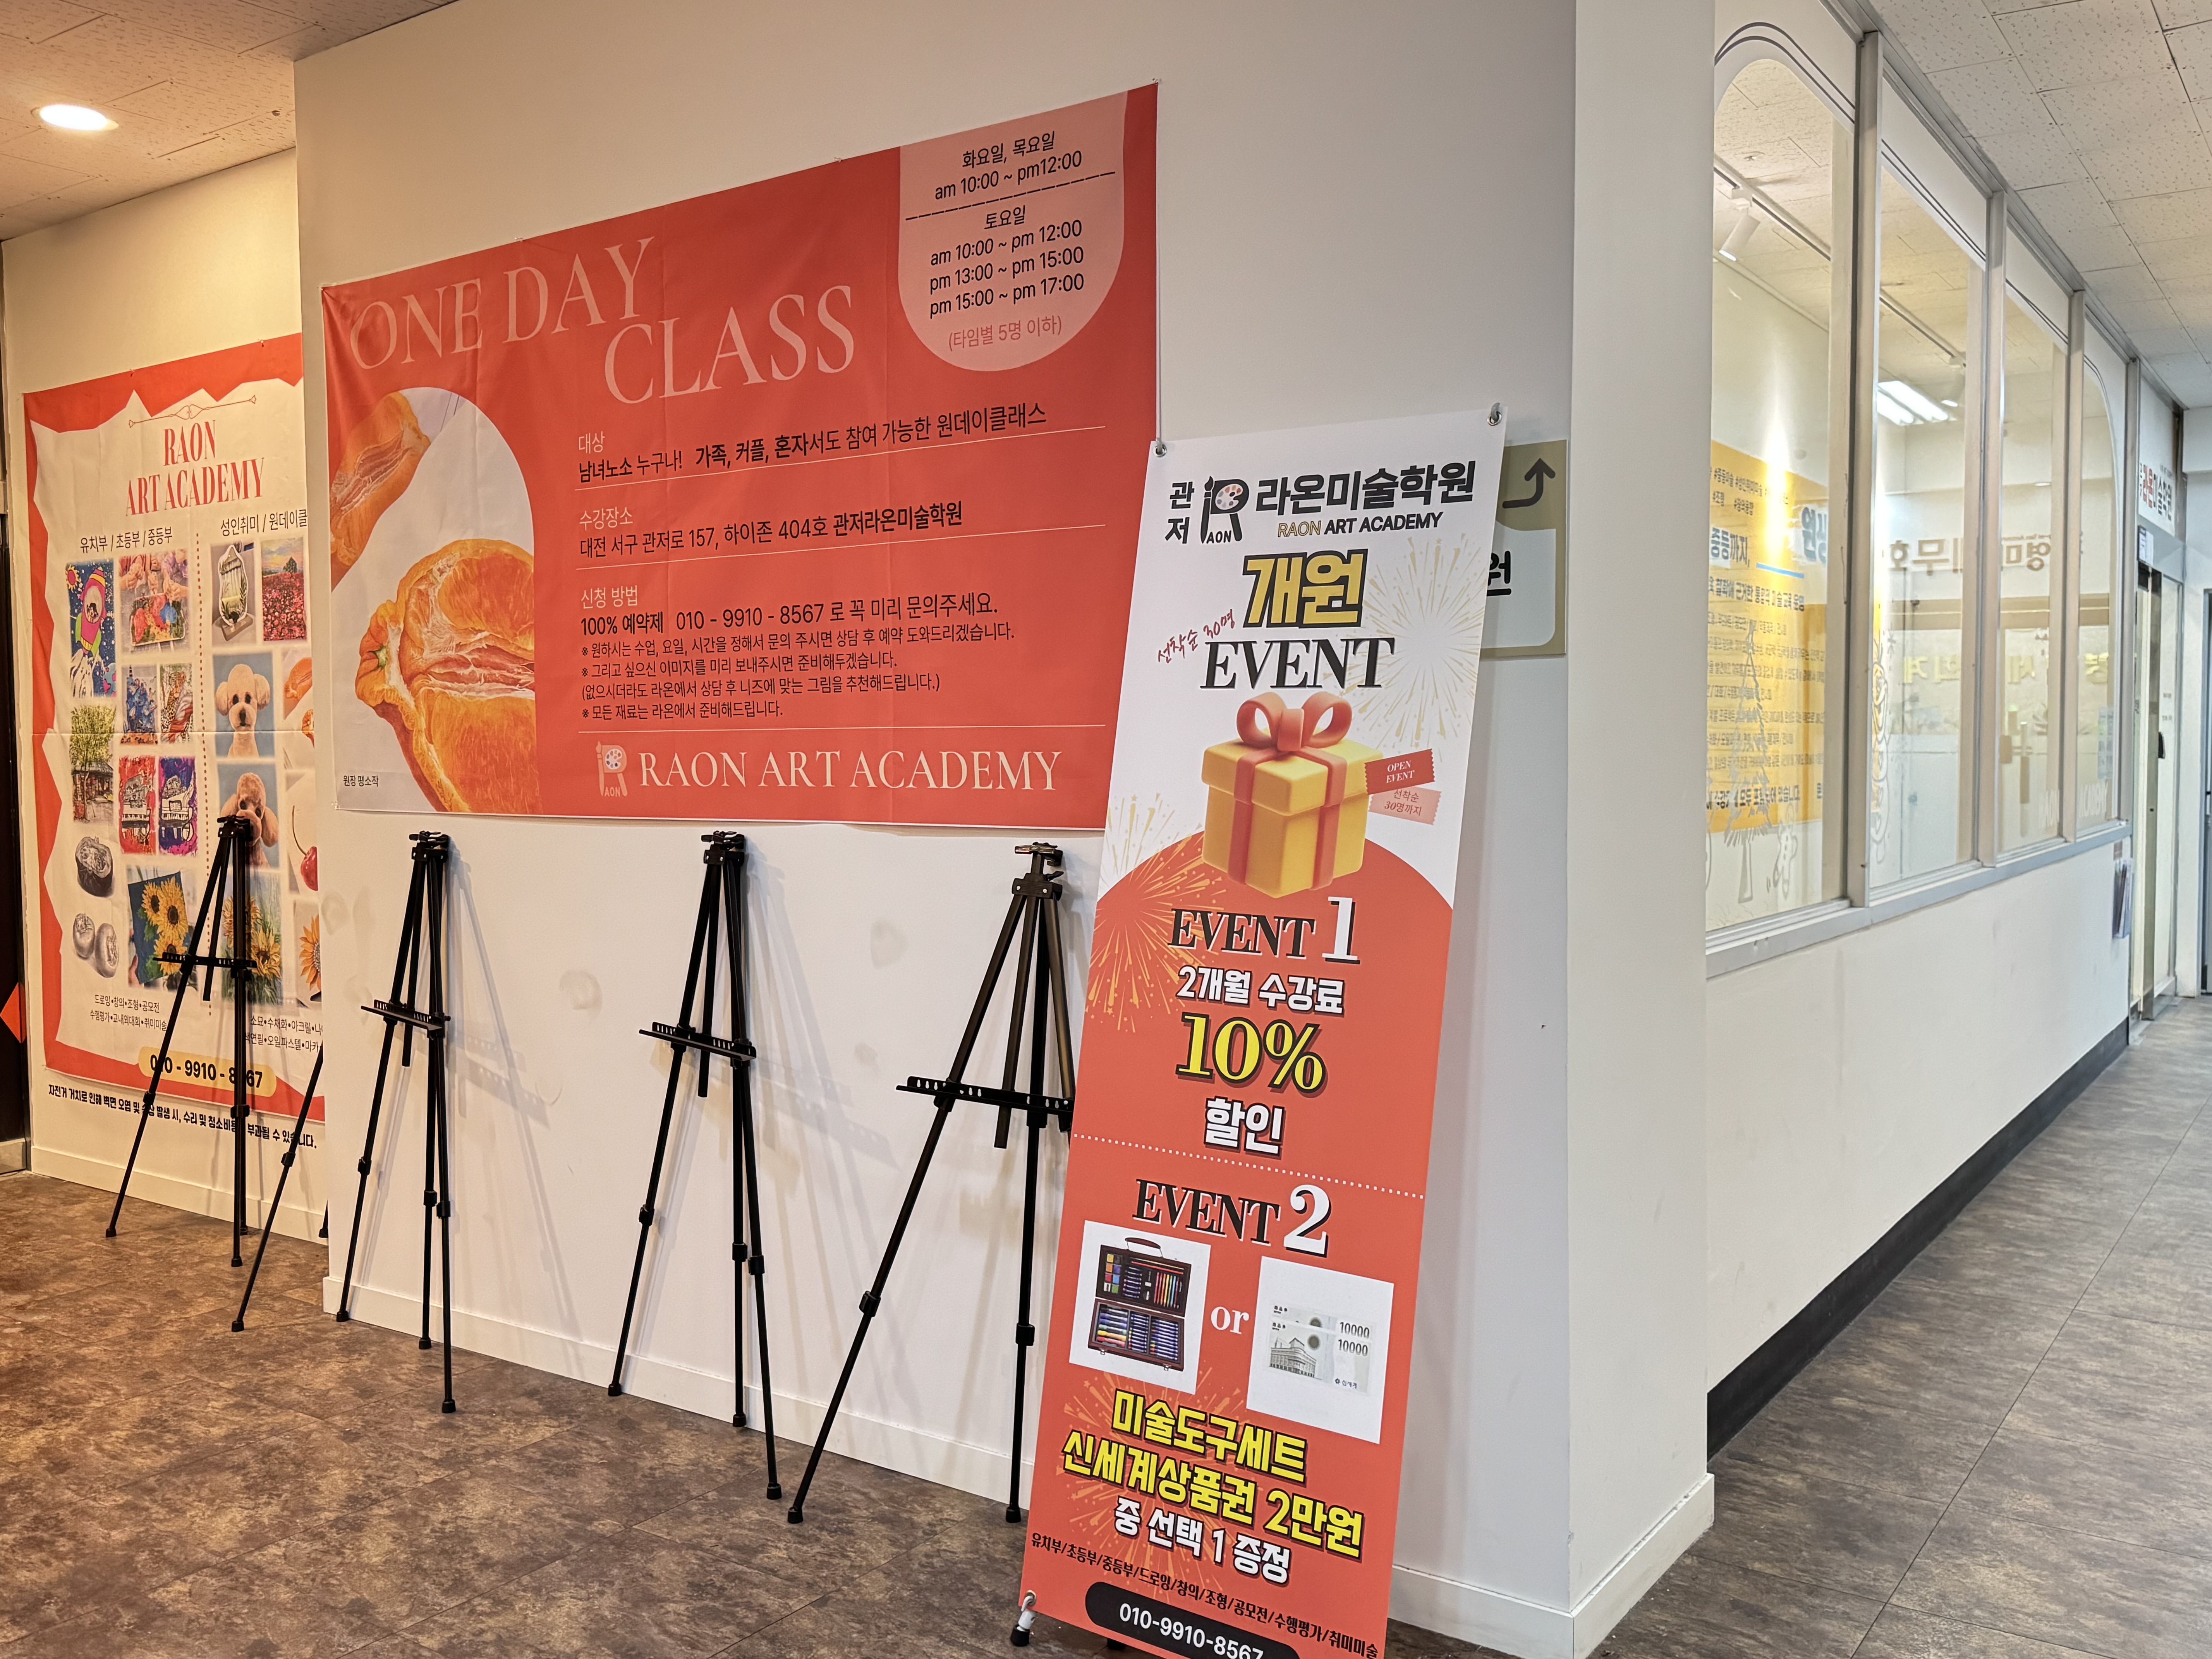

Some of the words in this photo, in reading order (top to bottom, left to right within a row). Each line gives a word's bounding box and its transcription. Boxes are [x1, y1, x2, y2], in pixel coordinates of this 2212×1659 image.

[962, 143, 1008, 169] 화요일,
[1012, 131, 1055, 157] 목요일
[934, 183, 957, 201] am
[960, 171, 1000, 195] 10:00
[1018, 150, 1082, 186] pm12:00
[984, 205, 1026, 230] 토요일
[931, 249, 951, 266] am
[955, 238, 994, 261] 10:00
[1011, 232, 1035, 252] pm
[1039, 219, 1083, 244] 12:00
[930, 275, 951, 295] pm
[955, 263, 994, 285] 13:00
[1012, 258, 1036, 279] pm
[1039, 246, 1085, 269] 15:00
[350, 278, 483, 370] ONE
[503, 236, 655, 343] DAY
[930, 300, 951, 319] pm
[955, 288, 994, 311] 15:00
[1013, 284, 1036, 305] pm
[1040, 273, 1085, 296] 17:00
[605, 285, 854, 404] CLASS
[949, 325, 994, 352] (타임별
[998, 320, 1022, 341] 5명
[1027, 315, 1062, 337] 이하)
[163, 419, 216, 467] RAON
[578, 431, 605, 454] 대상
[579, 457, 633, 483] 남녀노소
[636, 449, 682, 476] 누구나!
[696, 443, 732, 469] 가족,
[735, 438, 769, 464] 커플,
[774, 429, 841, 459] 혼자서도
[846, 423, 877, 450] 참여
[882, 416, 932, 444] 가능한
[936, 402, 1047, 438] 원데이클래스
[126, 473, 161, 517] ART
[164, 457, 264, 510] ACADEMY
[1255, 460, 1476, 516] 라온미술학원
[220, 517, 259, 536] 성인취미
[579, 507, 633, 531] 수강장소
[580, 535, 606, 558] 대전
[611, 534, 638, 555] 서구
[642, 530, 685, 553] 관저로
[689, 527, 719, 550] 157,
[724, 521, 773, 545] 하이존
[778, 515, 828, 539] 404호
[833, 500, 963, 537] 관저라온미술학원
[1278, 520, 1322, 538] RAON
[1324, 517, 1358, 535] ART
[1359, 512, 1443, 533] ACADEMY
[80, 535, 108, 554] 유치부
[116, 531, 140, 549] 초등부
[148, 527, 173, 546] 중등부
[580, 587, 607, 610] 신청
[611, 585, 638, 607] 방법
[1242, 549, 1368, 629] 개원
[581, 616, 618, 636] 100%
[622, 611, 664, 635] 예약제
[677, 610, 704, 631] 010
[723, 607, 763, 629] 9910
[780, 604, 824, 625] 8567
[830, 603, 845, 622] 로
[849, 599, 865, 622] 꼭
[871, 596, 902, 621] 미리
[906, 592, 998, 620] 문의주세요.
[591, 641, 632, 659] 원하시는
[634, 639, 659, 658] 수업,
[662, 638, 688, 656] 요일,
[691, 636, 727, 654] 시간을
[730, 634, 764, 653] 정해서
[768, 632, 791, 651] 문의
[795, 630, 833, 649] 주시면
[836, 629, 858, 647] 상담
[862, 628, 876, 646] 후
[878, 627, 903, 645] 예약
[907, 622, 1015, 643] 도와드리겠습니다.
[1158, 629, 1198, 663] 선착순
[591, 663, 622, 679] 그리고
[625, 661, 656, 678] 싶으신
[660, 658, 706, 677] 이미지를
[710, 657, 732, 675] 미리
[735, 655, 793, 673] 보내주시면
[798, 650, 897, 671] 준비해두겠습니다.
[1200, 638, 1395, 689] EVENT
[582, 684, 647, 701] (없으시더라도
[651, 681, 697, 698] 라온에서
[701, 680, 723, 696] 상담
[726, 678, 737, 696] 후
[740, 678, 775, 695] 니즈에
[779, 678, 803, 694] 맞는
[807, 675, 843, 693] 그림을
[846, 673, 940, 692] 추천해드립니다.)
[592, 704, 613, 720] 모든
[616, 704, 649, 720] 재료는
[652, 702, 696, 719] 라온에서
[699, 700, 783, 719] 준비해드립니다.
[343, 775, 356, 787] 원장
[638, 752, 748, 788] RAON
[758, 750, 841, 788] ART
[850, 750, 1062, 791] ACADEMY
[1386, 770, 1415, 783] EVENT
[1387, 760, 1412, 772] OPEN
[1384, 801, 1422, 816] 30명까지
[1394, 789, 1419, 802] 선착순
[1167, 908, 1316, 959] EVENT
[1322, 896, 1360, 964] 1
[1176, 965, 1251, 1005] 2개월
[1259, 973, 1345, 1015] 수강료
[150, 1054, 173, 1073] 00
[185, 1060, 216, 1081] 9910
[229, 1067, 263, 1088] 867
[1175, 1012, 1327, 1094] 10%
[48, 1084, 67, 1098] 자전거
[69, 1088, 88, 1102] 거치로
[89, 1092, 102, 1105] 인해
[103, 1096, 117, 1109] 벽면
[118, 1099, 131, 1112] 오염
[133, 1101, 140, 1114] 및
[157, 1106, 170, 1119] 발생
[184, 1111, 197, 1125] 수리
[199, 1113, 206, 1127] 및
[273, 1128, 280, 1141] 수
[1204, 1096, 1285, 1156] 할인
[1133, 1178, 1280, 1246] EVENT
[1283, 1183, 1332, 1257] 2
[1211, 1305, 1249, 1335] or
[1340, 1322, 1370, 1338] 10000
[1338, 1339, 1368, 1356] 10000
[1112, 1388, 1307, 1484] 미술도구세트
[1063, 1431, 1256, 1526] 신세계상품권
[1264, 1489, 1364, 1559] 2만원
[1113, 1497, 1142, 1537] 중
[1147, 1508, 1204, 1558] 선택
[1211, 1528, 1227, 1566] 1
[1233, 1534, 1291, 1584] 증정
